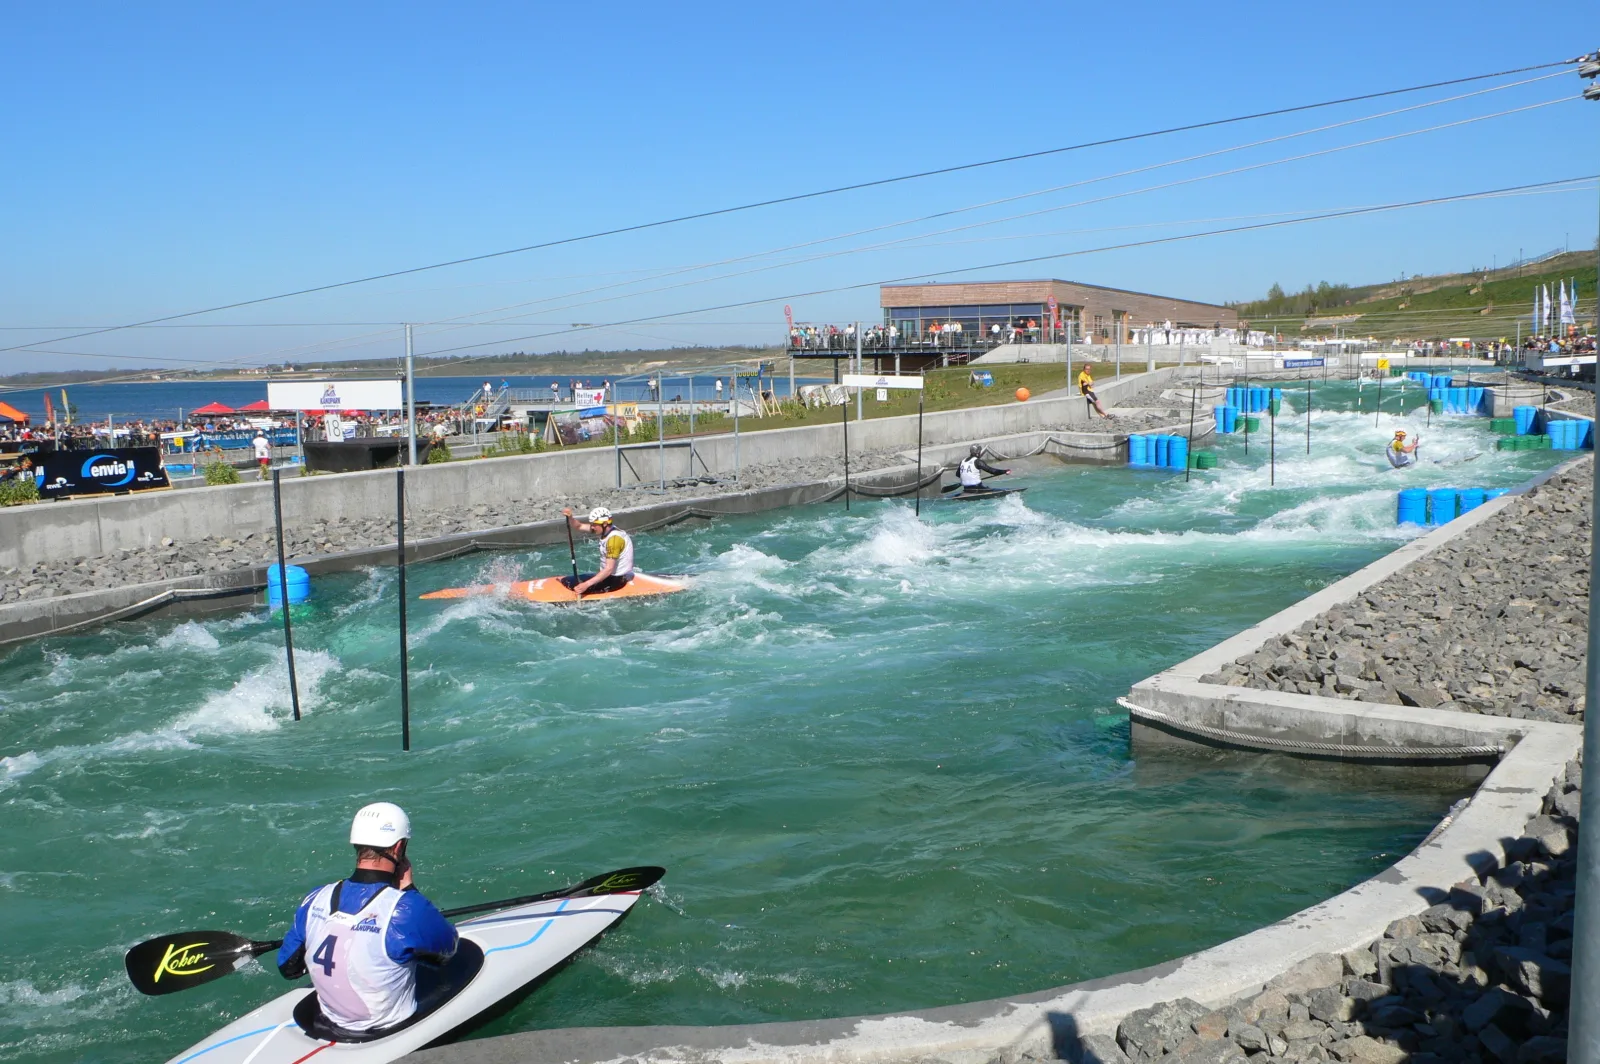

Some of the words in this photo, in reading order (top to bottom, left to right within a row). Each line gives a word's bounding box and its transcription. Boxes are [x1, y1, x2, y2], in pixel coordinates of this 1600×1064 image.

[878, 390, 887, 399] 17
[326, 419, 341, 437] 18
[350, 924, 382, 934] KANUPARK
[313, 934, 338, 977] 4
